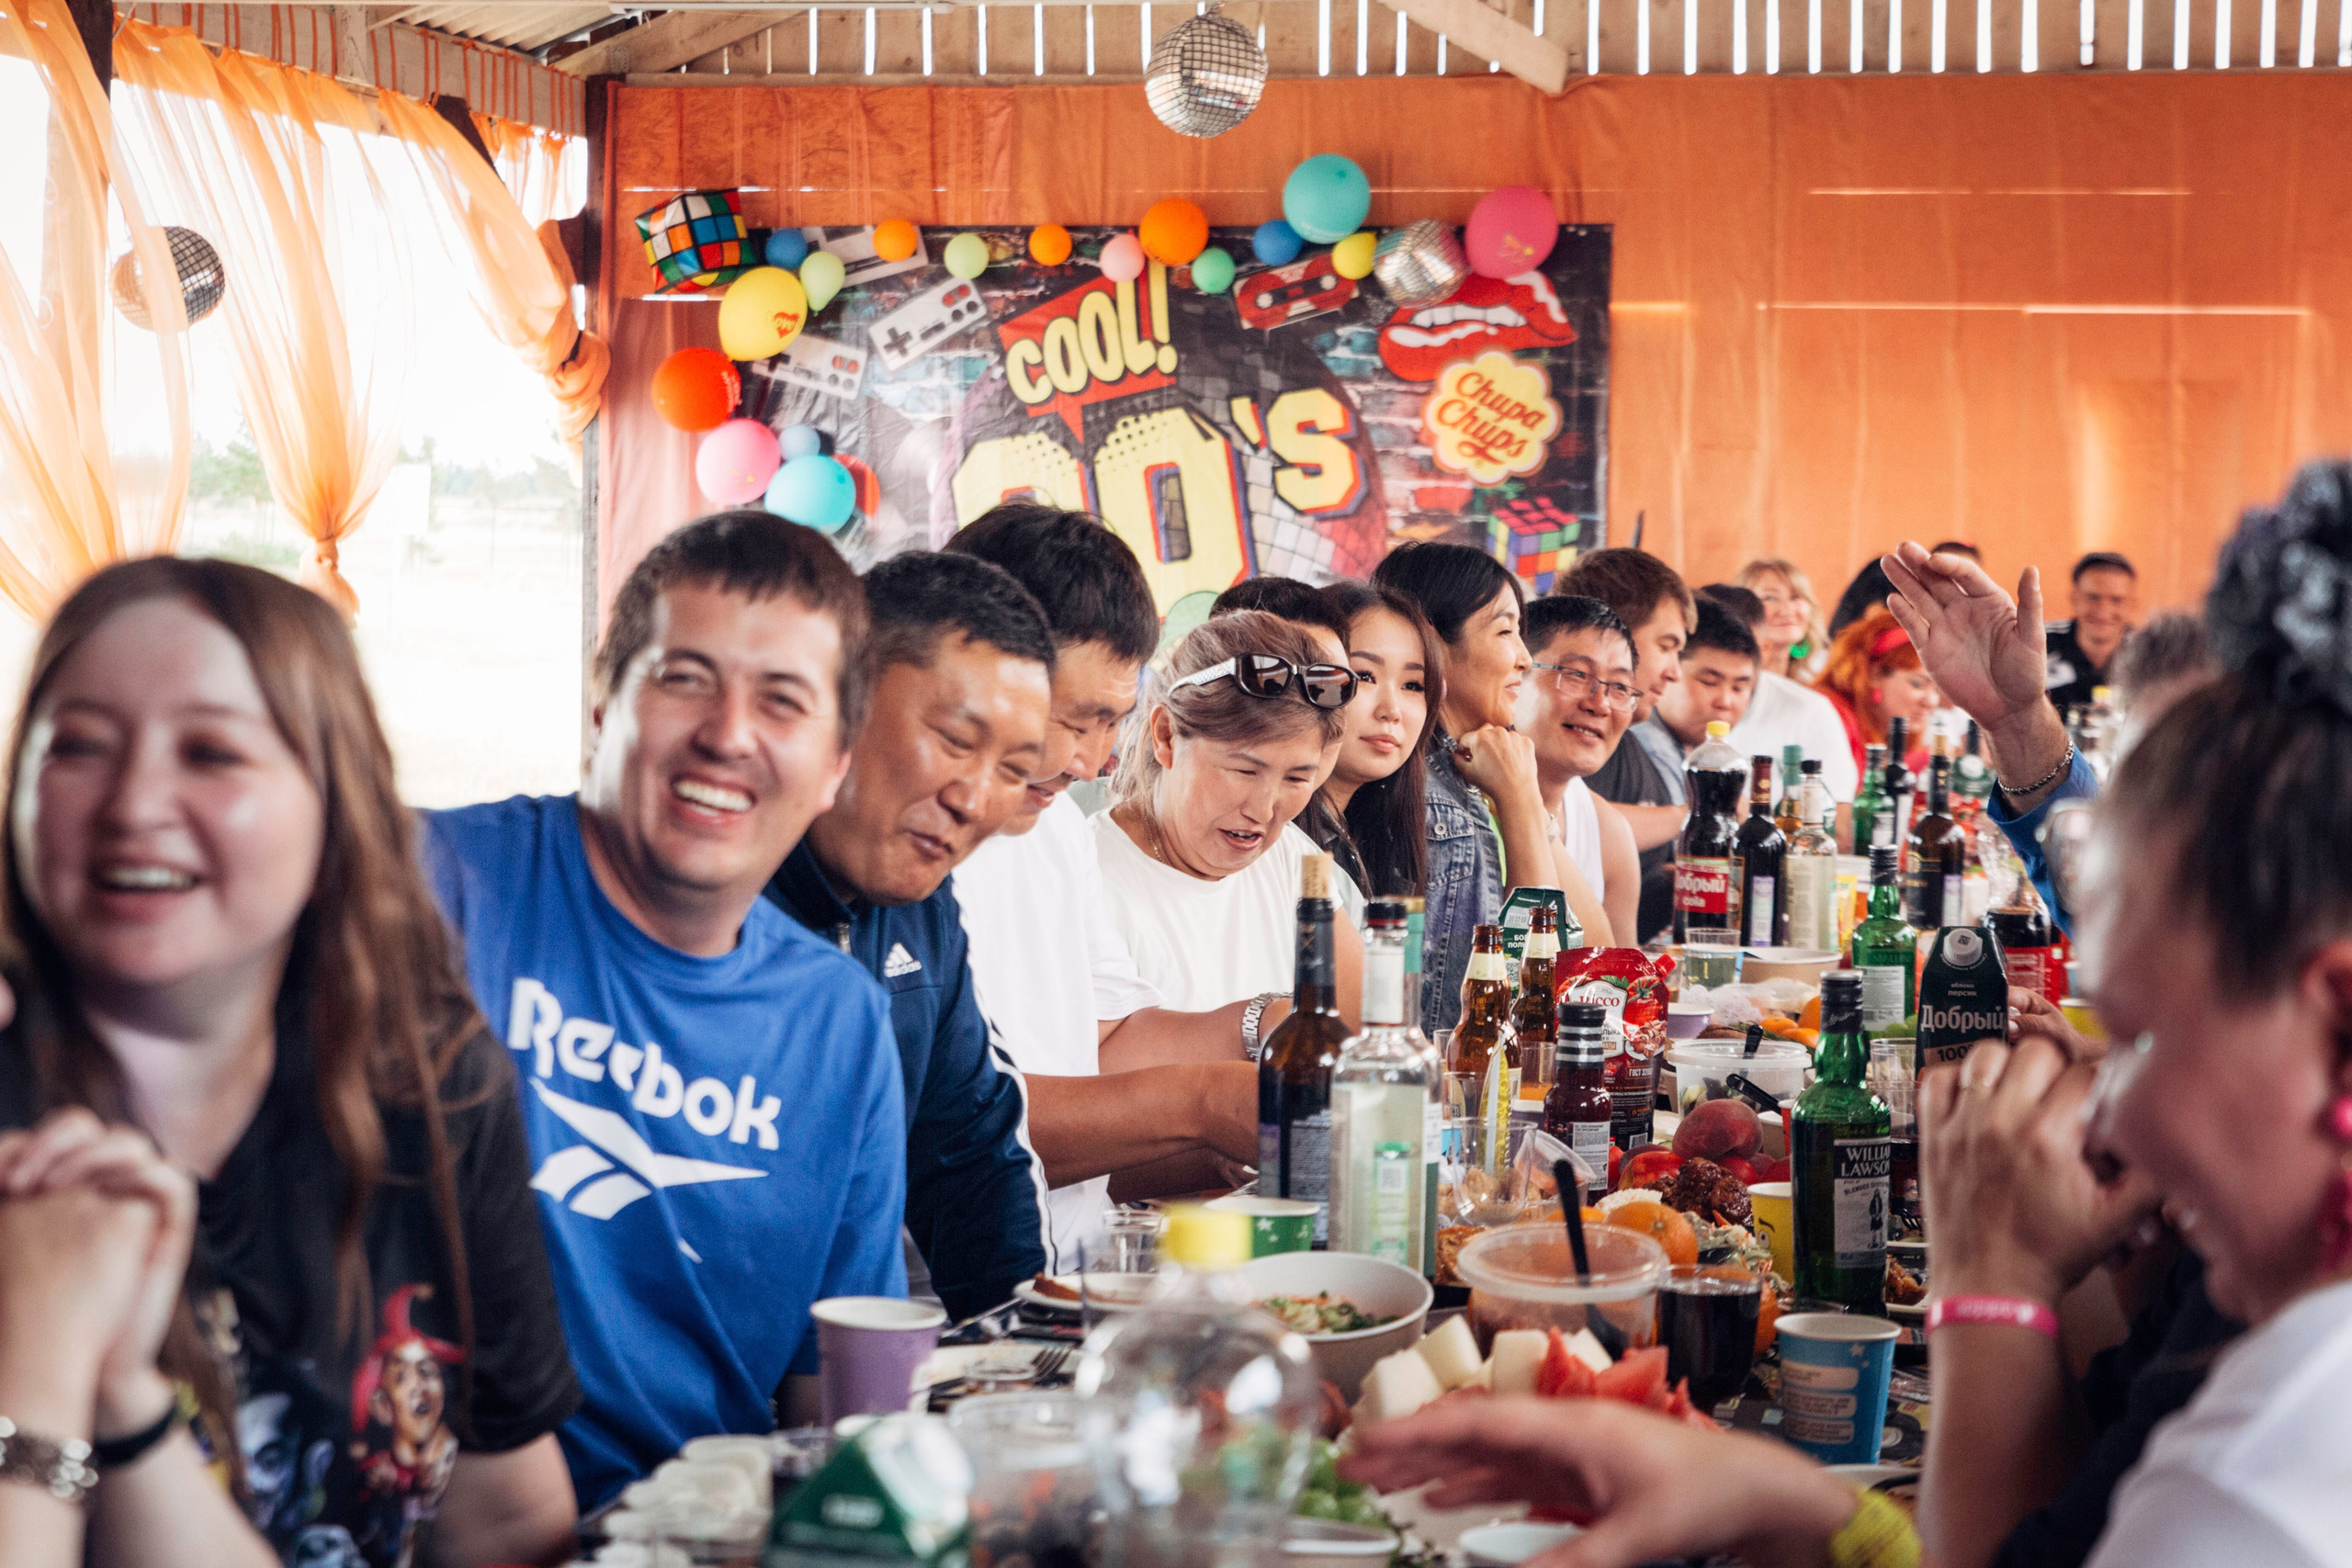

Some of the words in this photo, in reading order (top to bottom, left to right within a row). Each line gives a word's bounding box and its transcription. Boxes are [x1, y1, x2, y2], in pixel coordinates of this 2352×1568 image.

[1006, 261, 1178, 404] COOL!
[1436, 399, 1529, 466] Chups
[1456, 371, 1546, 432] Chupa
[1920, 1004, 2004, 1033] Добрый
[507, 976, 782, 1150] Reebok
[1938, 1044, 1973, 1062] 100
